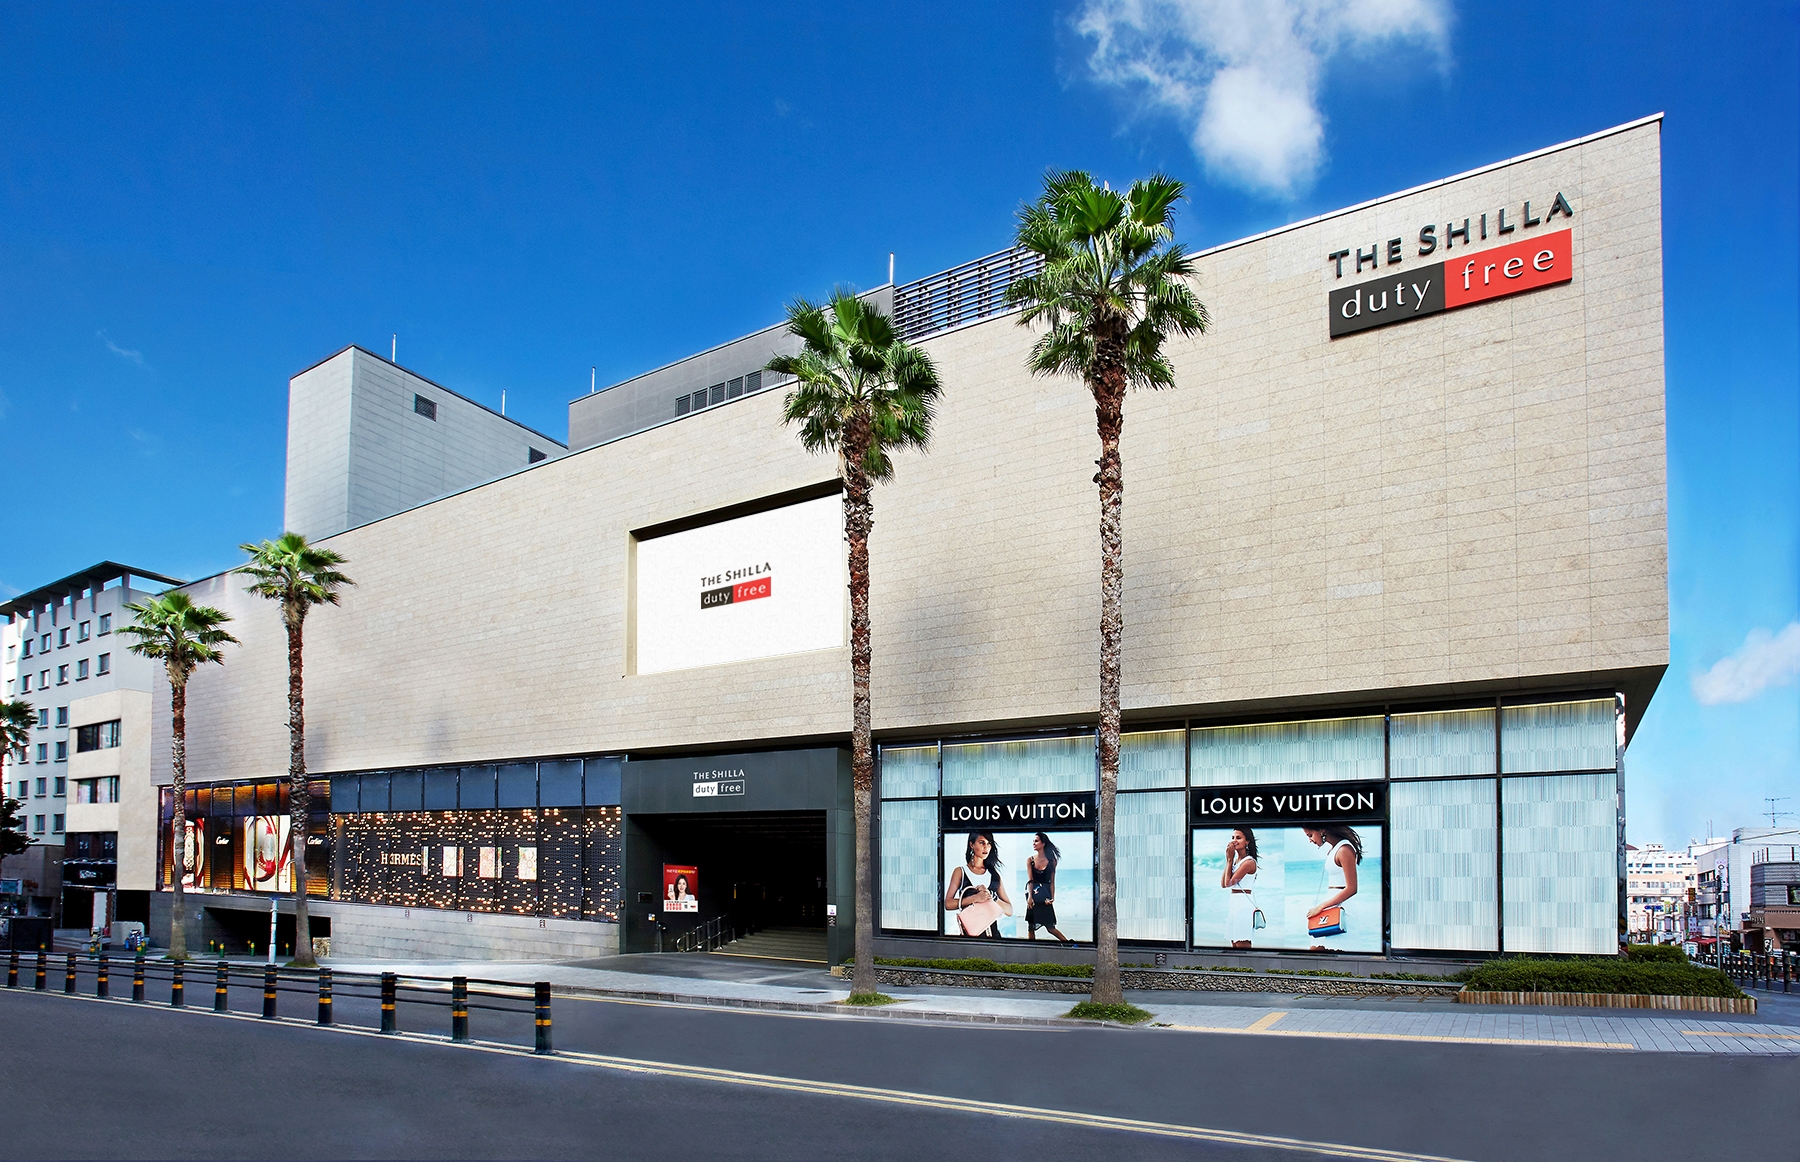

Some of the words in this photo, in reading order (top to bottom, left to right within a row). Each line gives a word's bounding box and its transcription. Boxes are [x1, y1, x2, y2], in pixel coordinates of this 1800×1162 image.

[1328, 236, 1403, 278] THE
[1418, 191, 1573, 256] SHILLA
[1341, 279, 1432, 319] duty
[1461, 248, 1555, 291] free
[701, 574, 722, 587] THE
[725, 562, 772, 582] SHILLA
[703, 592, 731, 605] duty
[737, 584, 767, 598] free
[693, 771, 710, 780] THE
[711, 769, 745, 779] SHILLA
[695, 785, 716, 795] duty
[720, 783, 741, 793] free
[951, 805, 1001, 821] LOUIS
[1006, 802, 1086, 820] VUITTON
[1201, 796, 1264, 815] LOUIS
[1272, 792, 1374, 812] VUITTON
